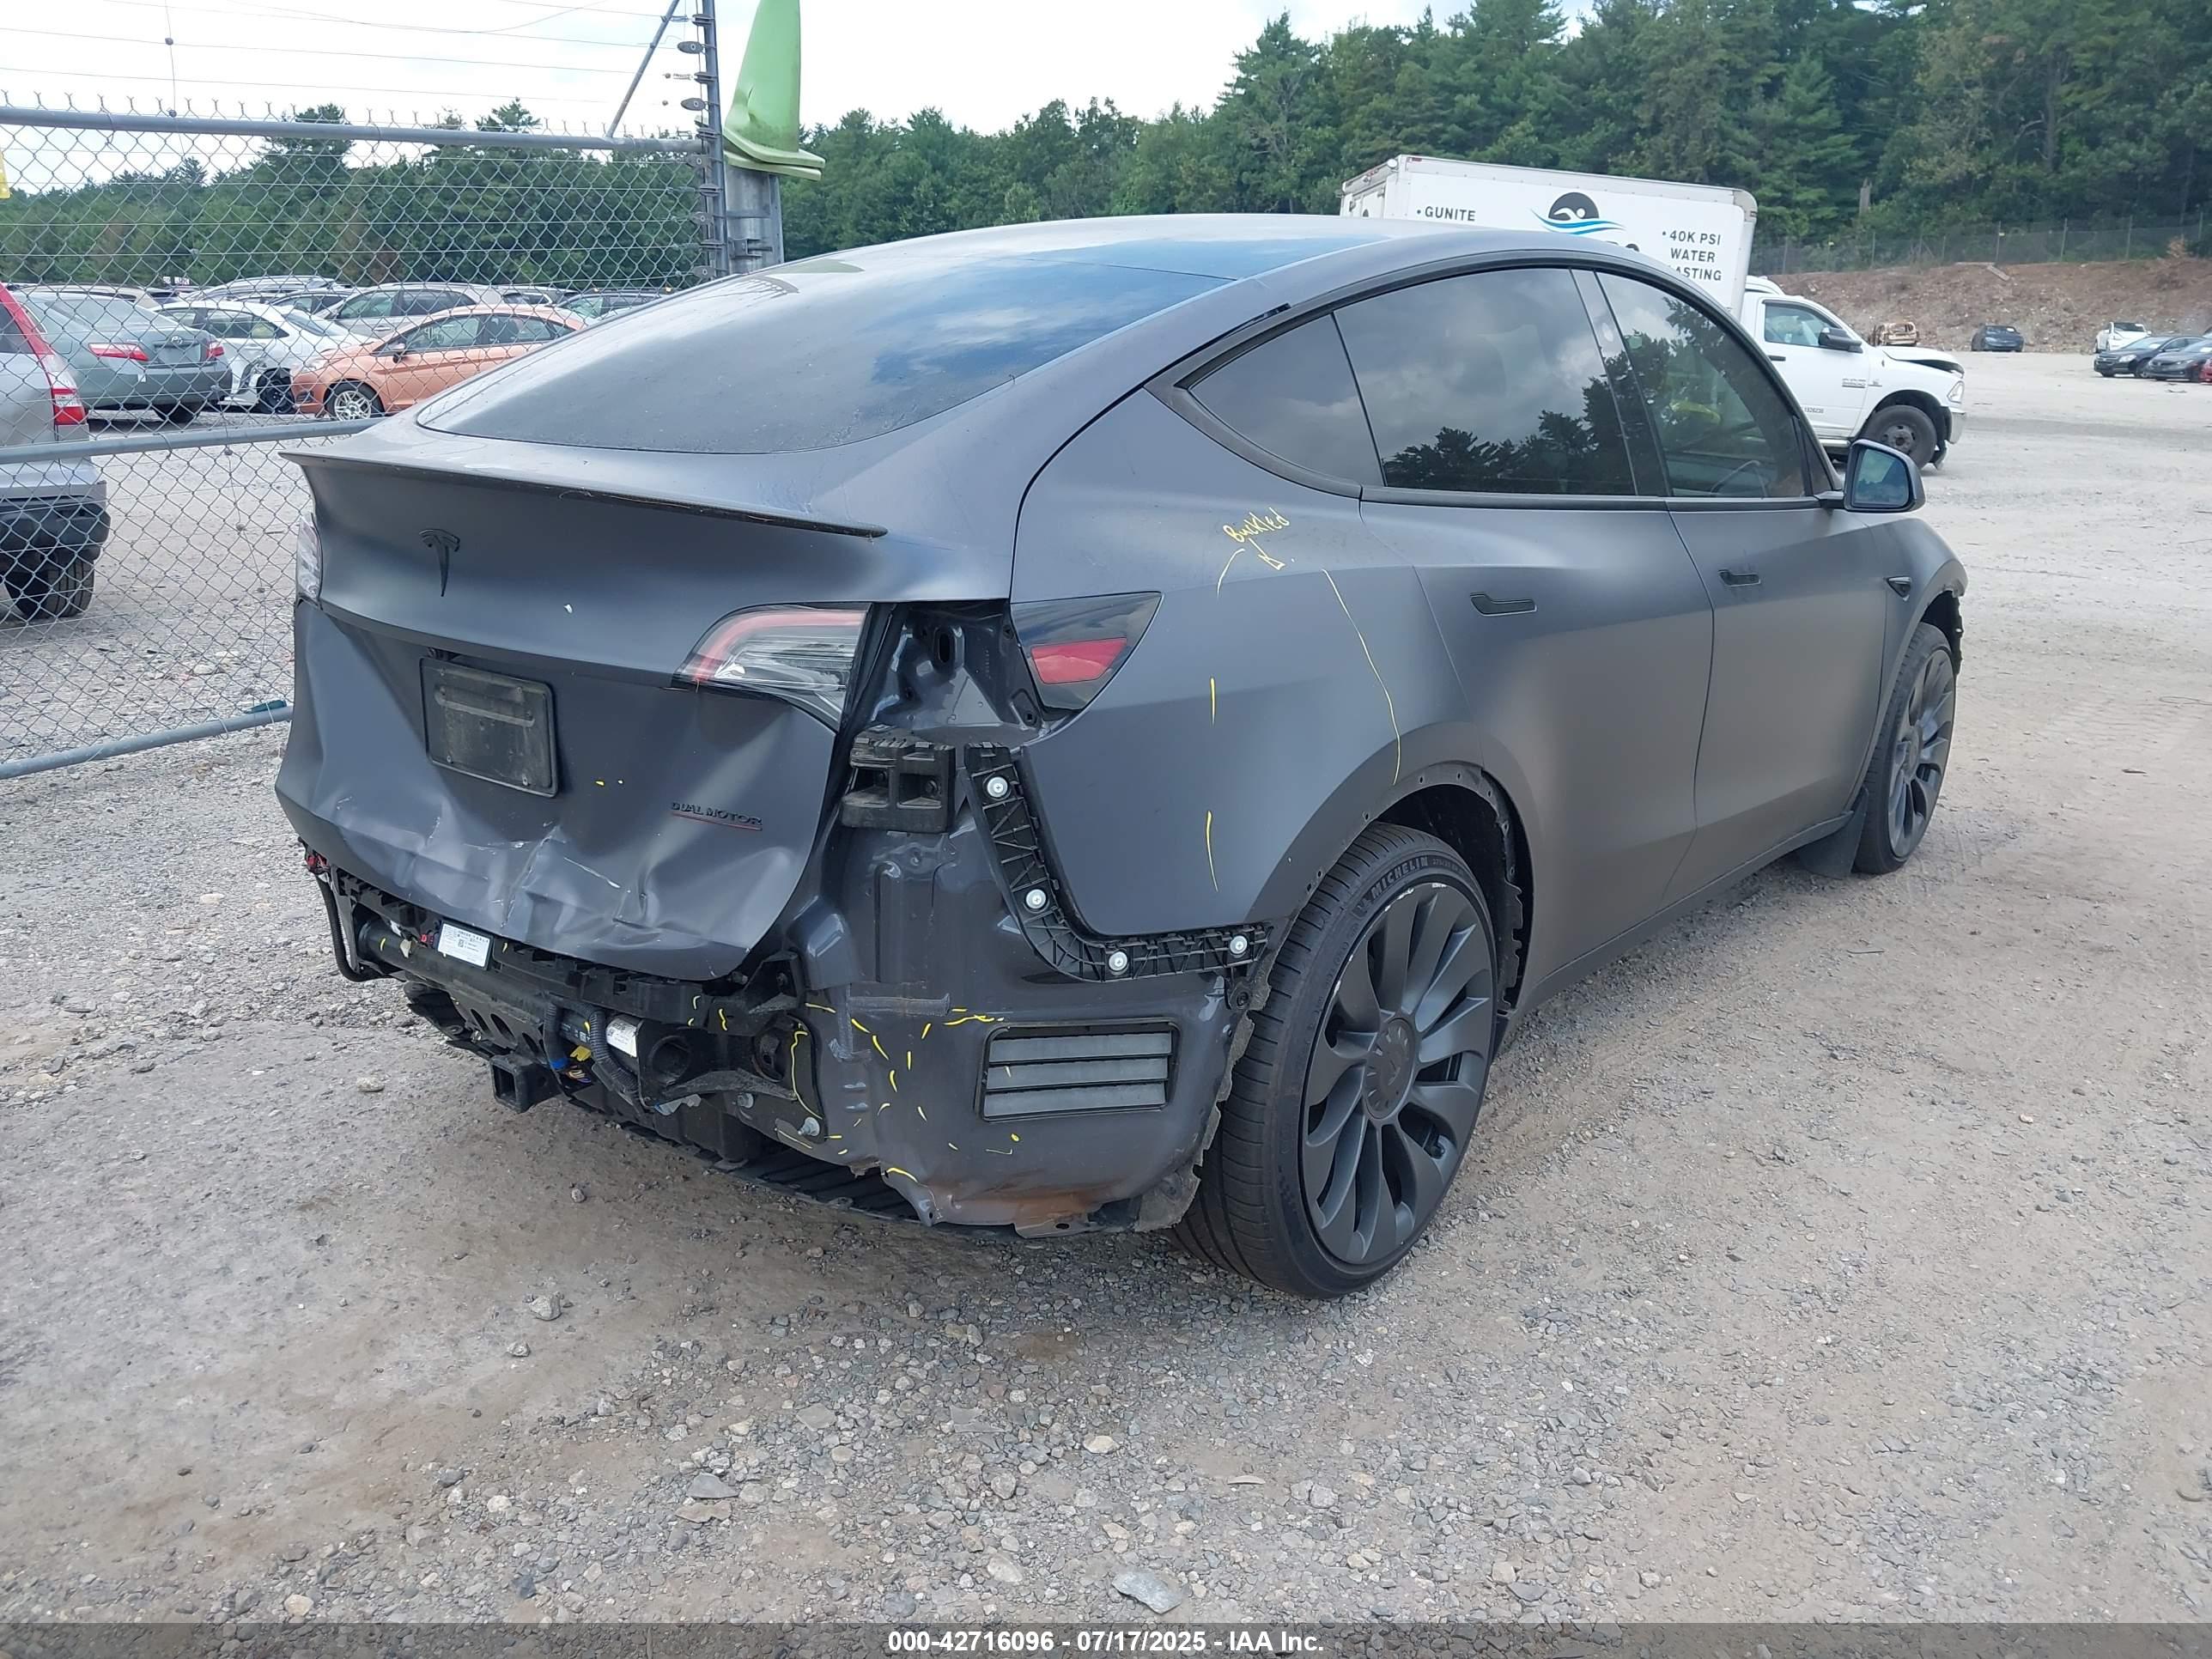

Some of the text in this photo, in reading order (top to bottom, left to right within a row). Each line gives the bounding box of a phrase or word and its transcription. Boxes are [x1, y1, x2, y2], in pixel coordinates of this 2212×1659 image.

[1425, 206, 1476, 222] GUNITE
[1669, 230, 1721, 246] 40K PSI
[1670, 247, 1716, 263] WATER
[1668, 264, 1723, 281] ASTING
[672, 802, 763, 825] DUAL MOTOR
[1371, 857, 1429, 899] MICHELIN
